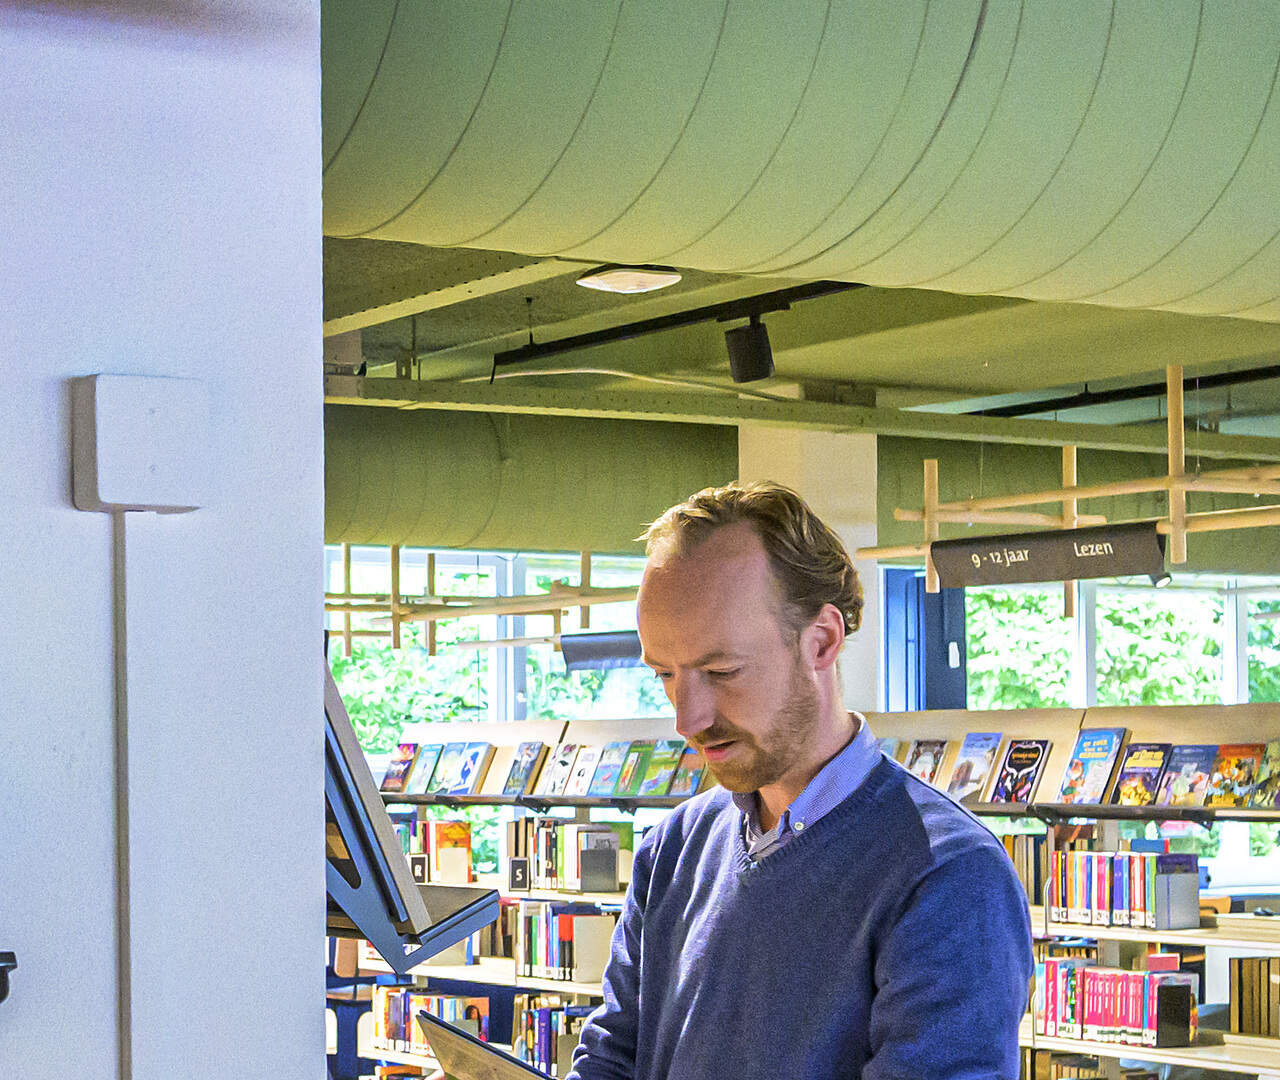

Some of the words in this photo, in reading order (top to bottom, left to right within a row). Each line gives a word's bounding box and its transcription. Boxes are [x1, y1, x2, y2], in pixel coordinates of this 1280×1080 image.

[1073, 542, 1114, 557] Lezen
[971, 553, 981, 568] 9
[989, 551, 1003, 563] 12
[1004, 548, 1030, 567] jaar
[515, 868, 524, 881] S
